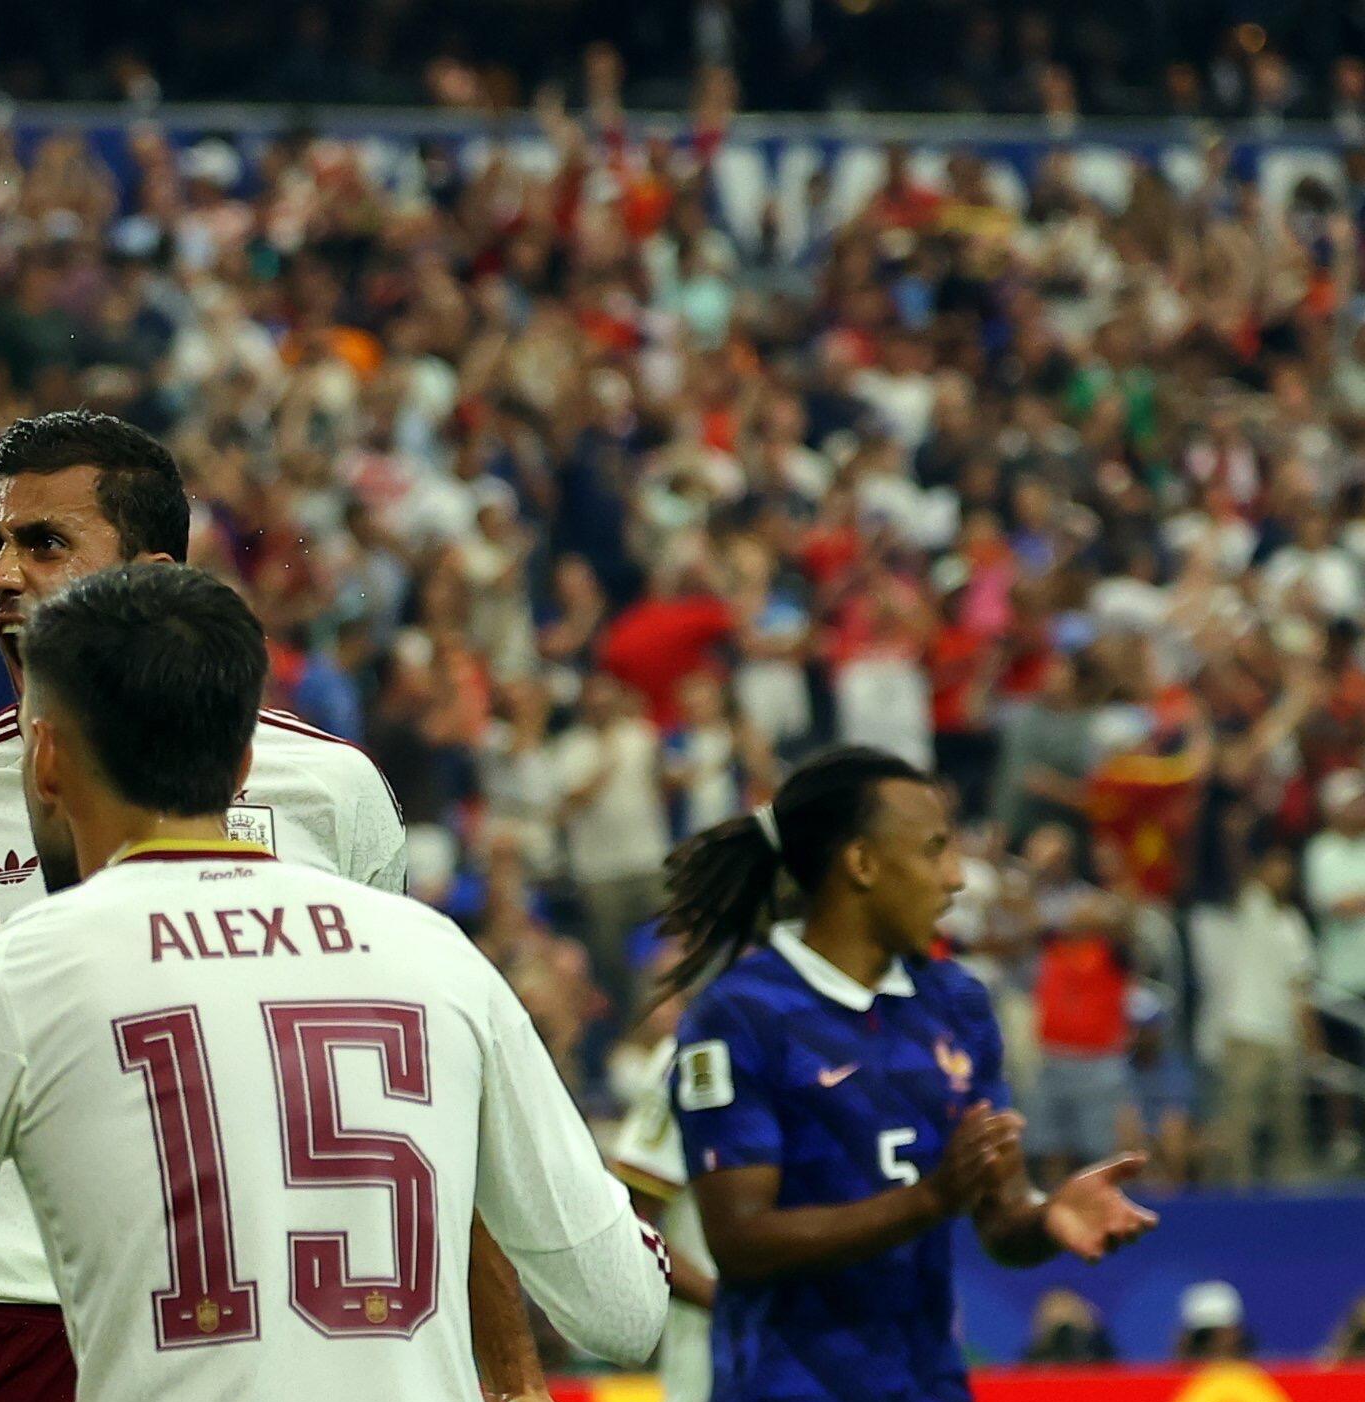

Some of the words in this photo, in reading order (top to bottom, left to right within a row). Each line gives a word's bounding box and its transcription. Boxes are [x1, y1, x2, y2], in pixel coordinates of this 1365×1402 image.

[149, 906, 301, 963] ALEX
[305, 903, 371, 954] B.
[111, 998, 440, 1352] 15
[876, 1126, 920, 1187] 5
